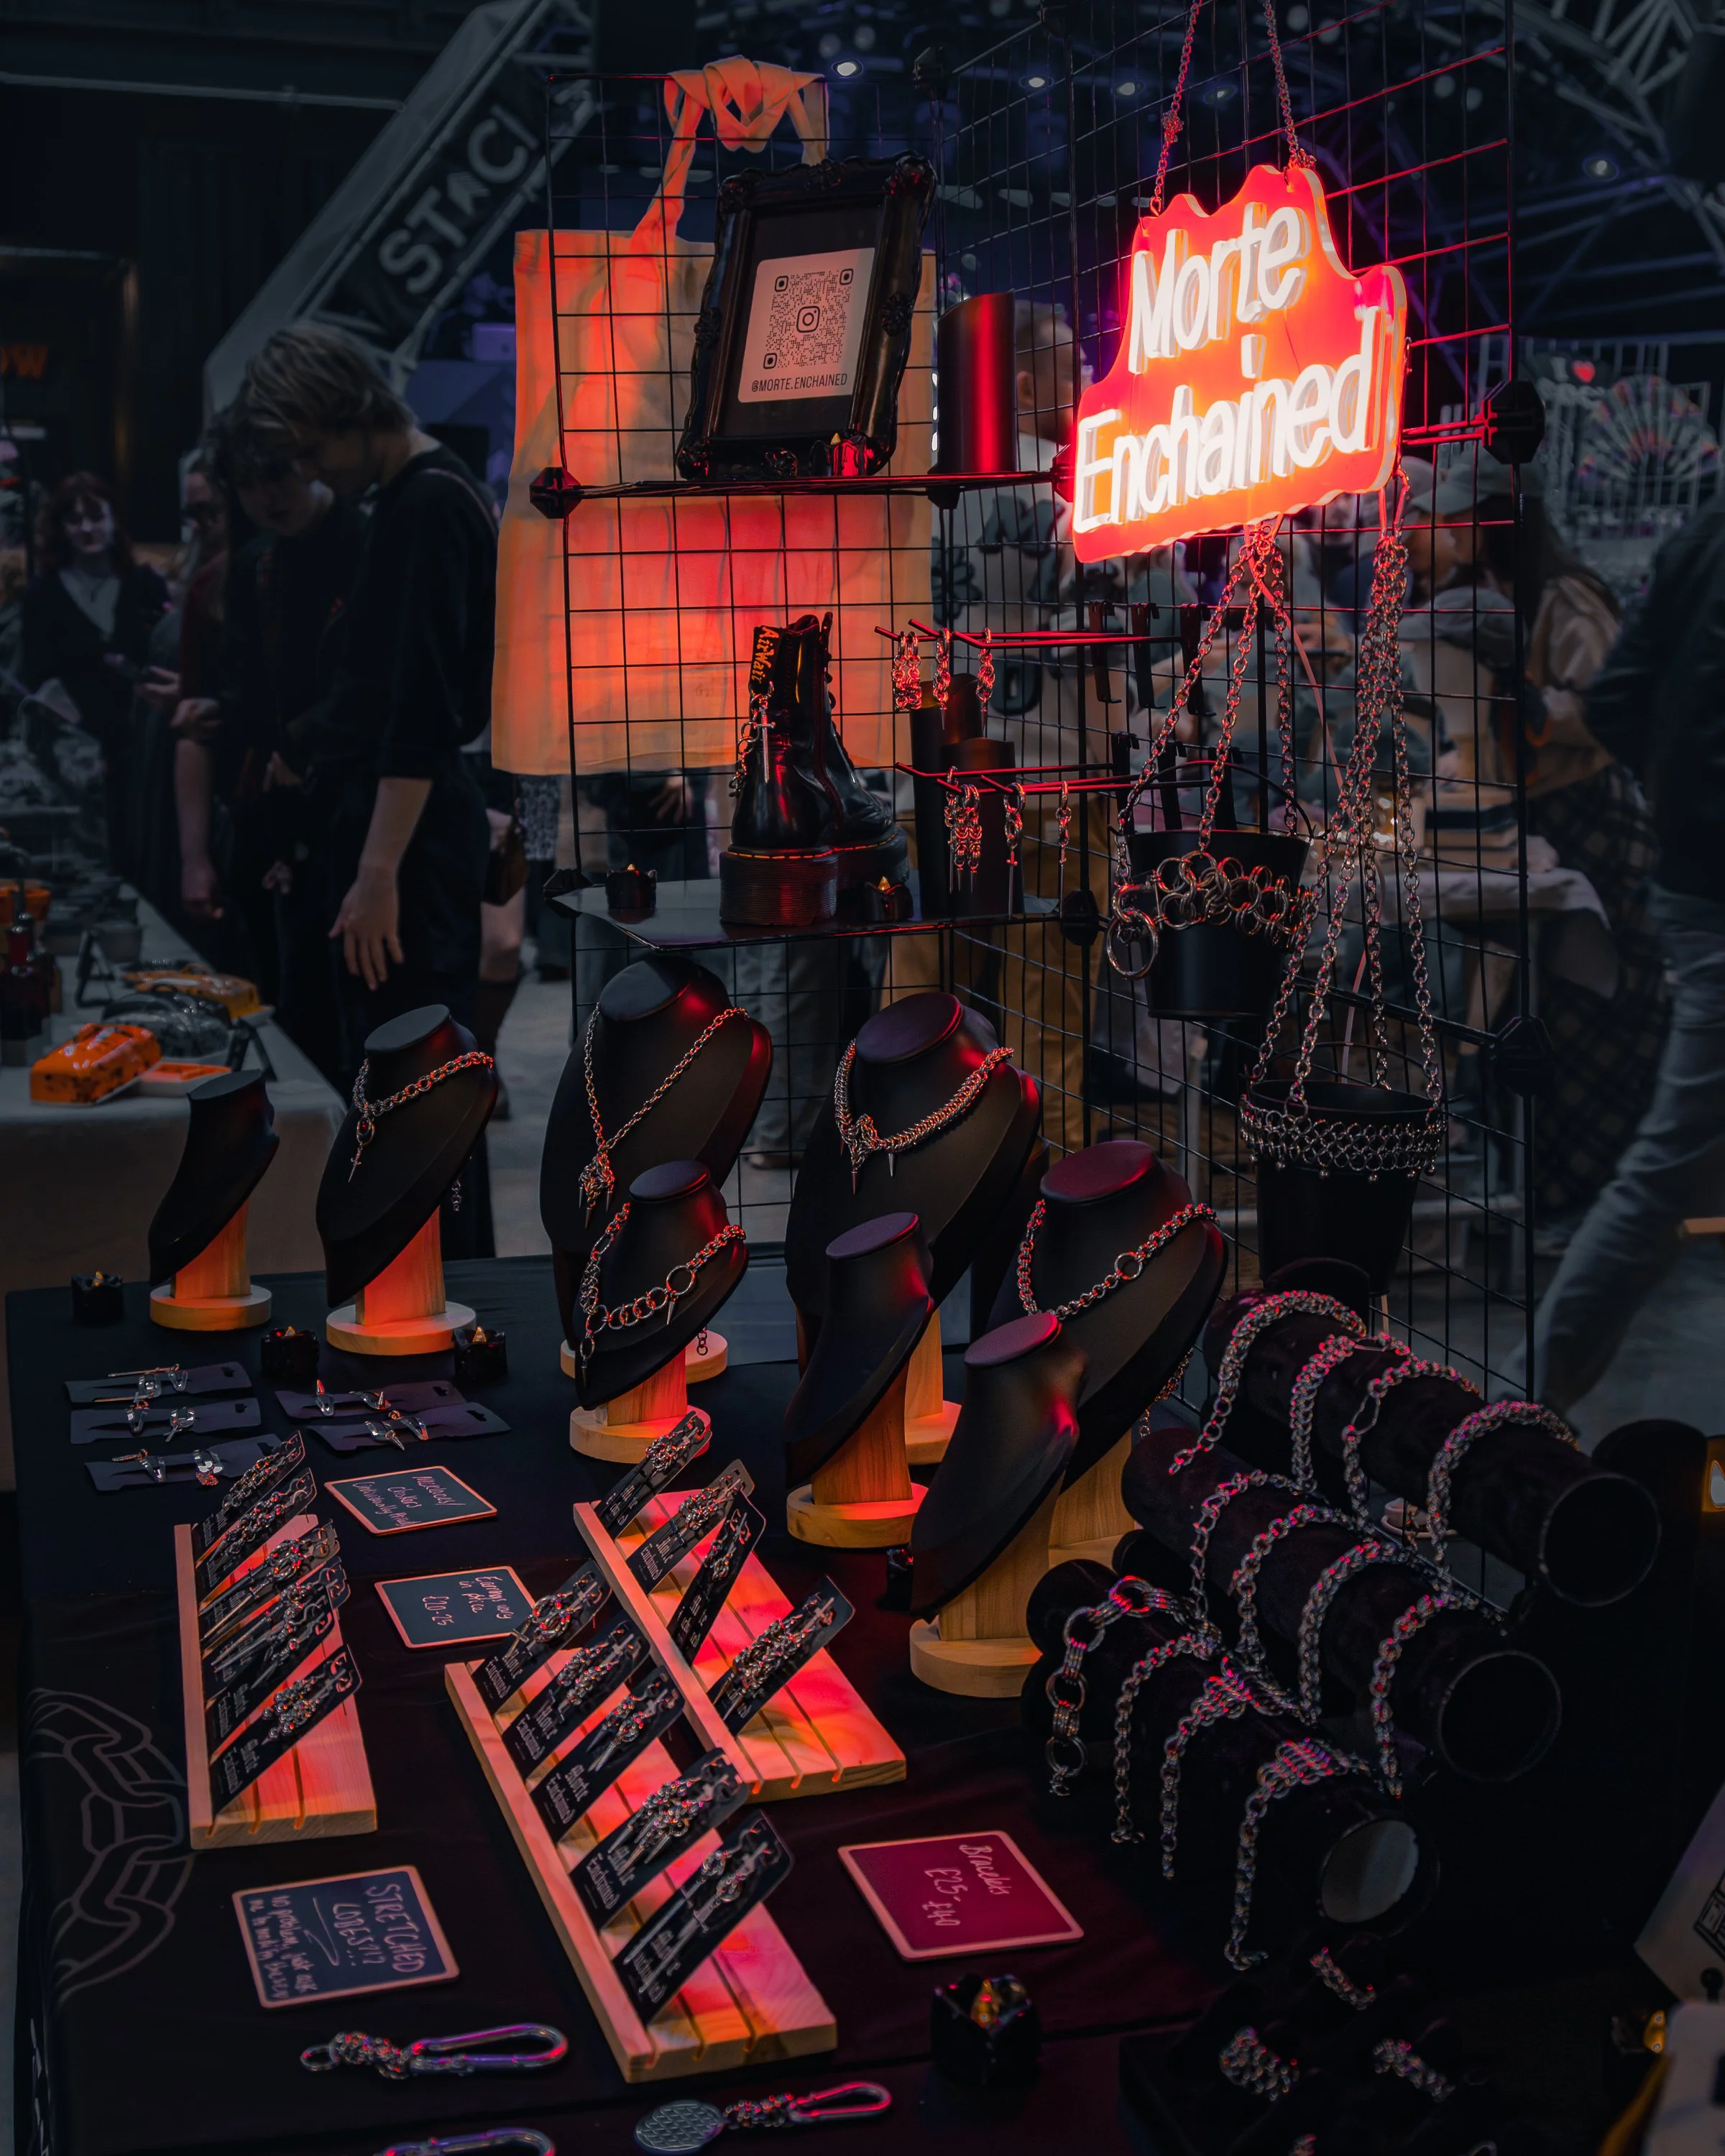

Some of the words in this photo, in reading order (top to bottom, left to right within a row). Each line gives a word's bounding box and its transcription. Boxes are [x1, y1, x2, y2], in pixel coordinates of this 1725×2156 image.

[1128, 201, 1310, 374] Morte
[751, 373, 847, 392] @MORTE.ENCHAINED
[1073, 305, 1383, 535] Enchained
[422, 1595, 454, 1626] £20-25
[958, 1843, 1012, 1895] Bracelets
[363, 1883, 427, 1973] STRETCHED
